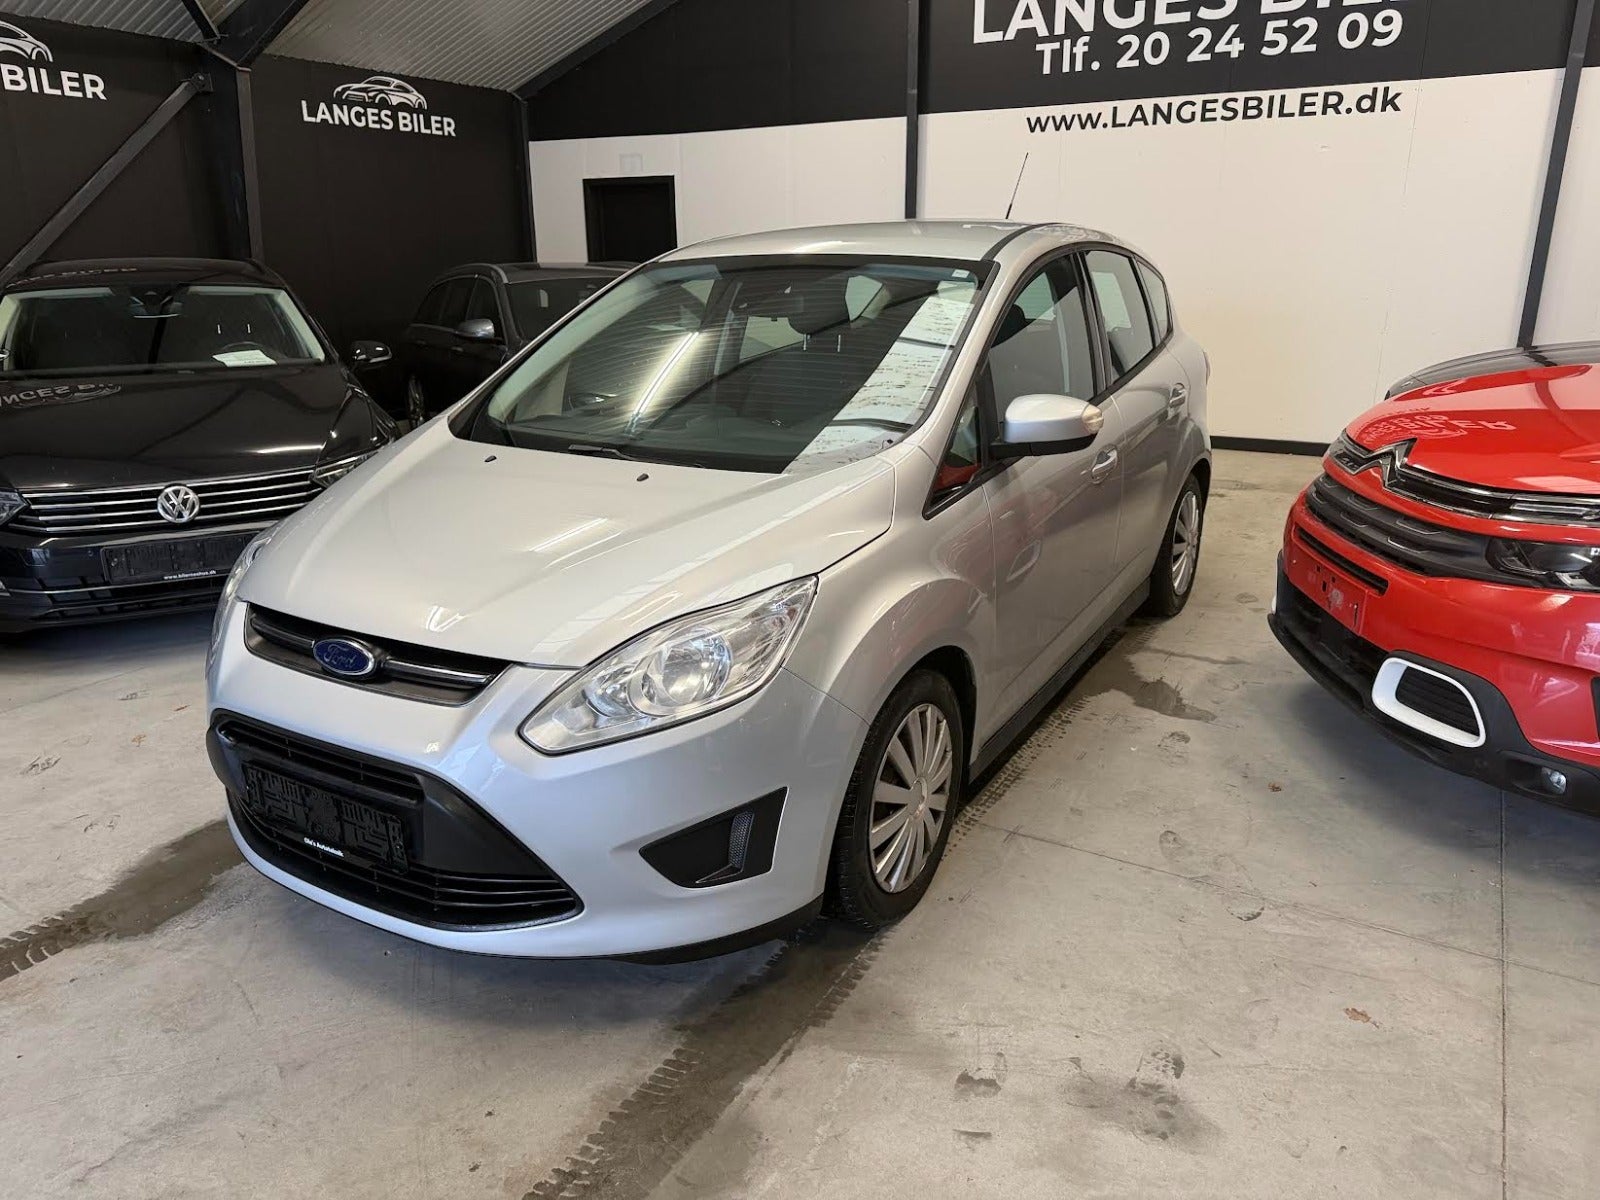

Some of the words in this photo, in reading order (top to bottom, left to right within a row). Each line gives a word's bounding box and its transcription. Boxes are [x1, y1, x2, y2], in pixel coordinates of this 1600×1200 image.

[1036, 36, 1101, 75] Tlf.
[1115, 30, 1170, 68] 20
[1186, 24, 1245, 63] 24
[1260, 16, 1318, 56] 52
[1337, 8, 1403, 50] 09
[0, 63, 107, 100] BILER
[301, 100, 394, 130] LANGES
[397, 111, 456, 137] BILER
[1026, 86, 1402, 133] www.LANGESBILER.dk
